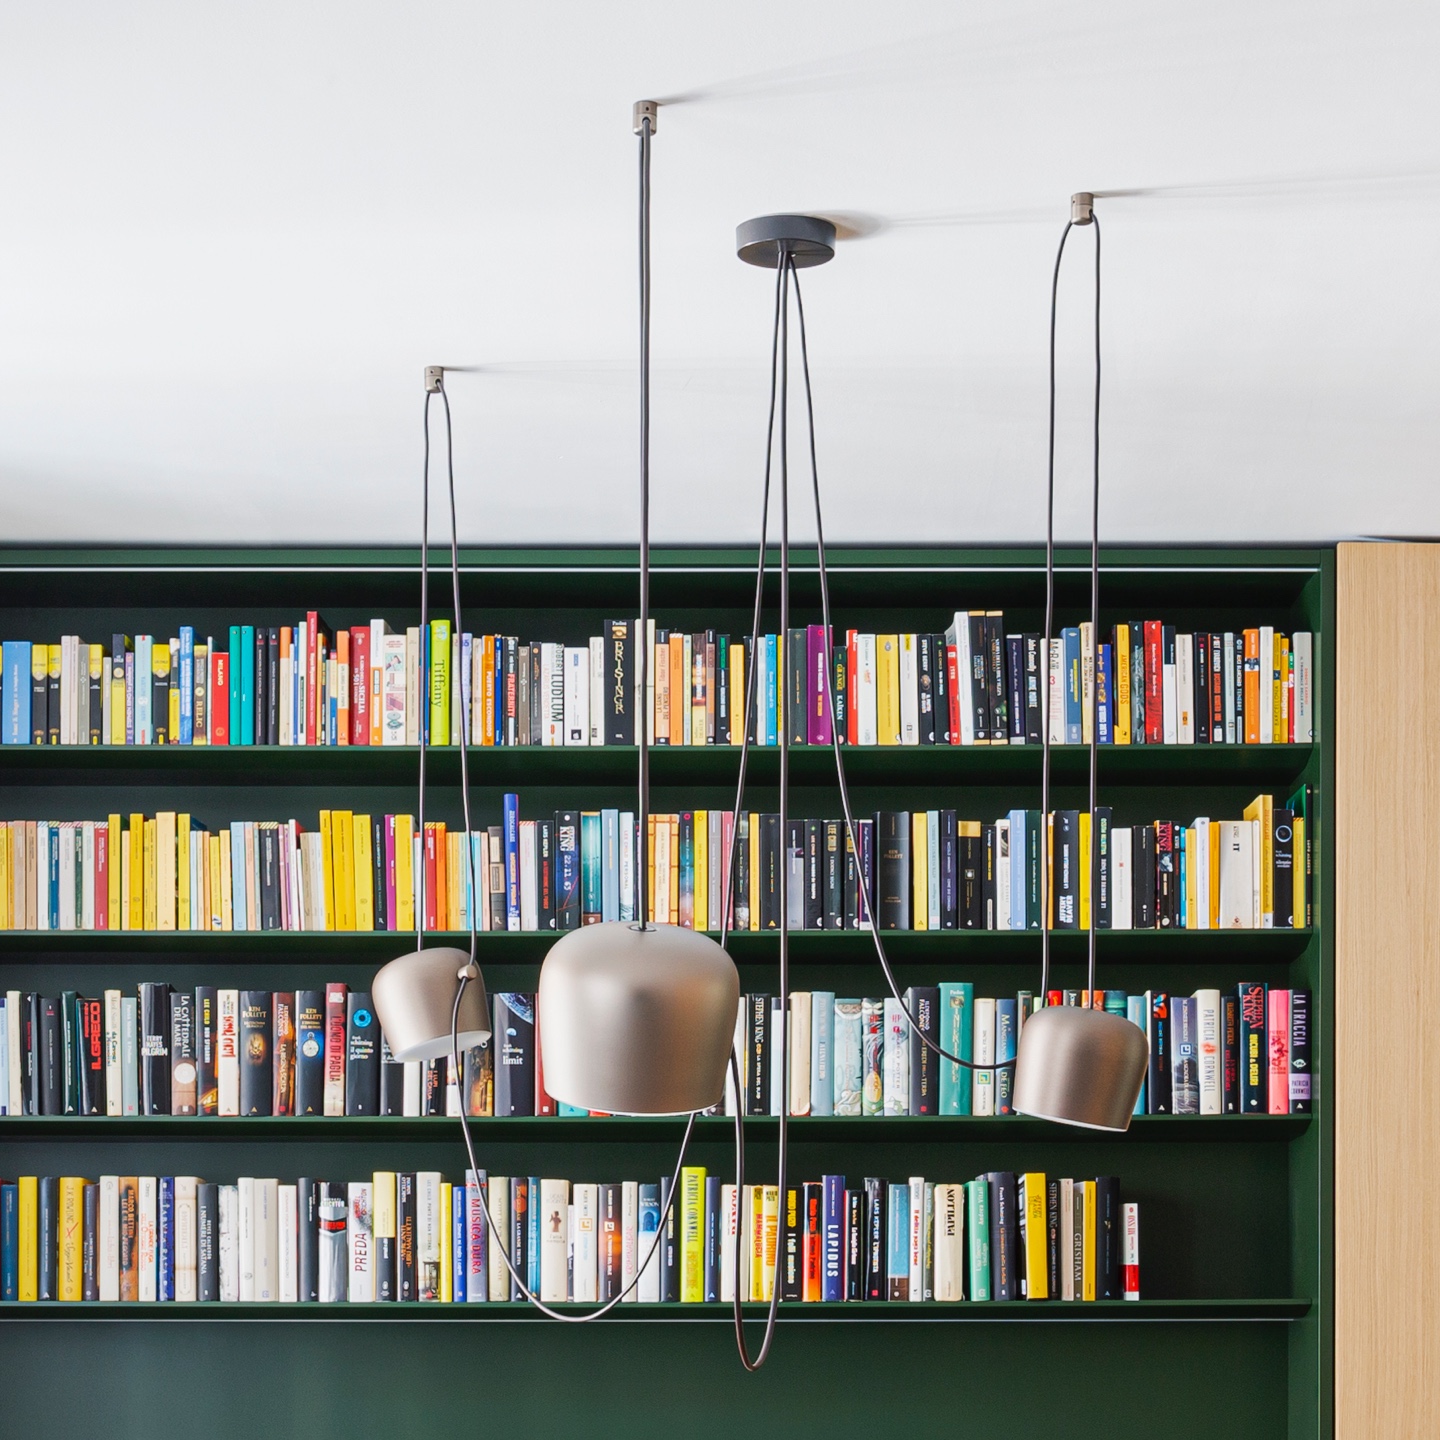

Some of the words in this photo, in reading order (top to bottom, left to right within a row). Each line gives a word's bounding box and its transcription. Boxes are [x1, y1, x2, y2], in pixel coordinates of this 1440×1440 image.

[431, 660, 445, 708] Tiffany
[551, 674, 563, 722] LUDLUM
[1120, 684, 1128, 704] GODS
[560, 826, 569, 851] KING
[1233, 843, 1240, 852] IT
[181, 996, 190, 1005] LA
[755, 998, 764, 1025] STEPHEN
[1243, 995, 1253, 1021] KING
[1249, 987, 1263, 1029] STEPHEN
[1293, 995, 1306, 1004] LA
[90, 1002, 101, 1056] GRECO
[181, 1007, 190, 1057] CATTEDRALE
[330, 1016, 343, 1043] L'UOMO
[755, 1027, 764, 1043] KING
[1203, 1009, 1214, 1041] PATRICIA
[1293, 1009, 1306, 1046] TRACCIA
[141, 1048, 168, 1056] PILGRIM
[503, 1055, 523, 1065] limit
[329, 1056, 342, 1082] PAGLIA
[1000, 1072, 1007, 1082] DE
[1204, 1056, 1215, 1092] CORNWELL
[687, 1175, 698, 1206] PATRICIA
[471, 1198, 481, 1242] MUSICA
[687, 1208, 698, 1242] CORNWELL
[355, 1233, 366, 1272] PREDA
[472, 1245, 481, 1274] DURA
[827, 1224, 838, 1277] LAPIDUS
